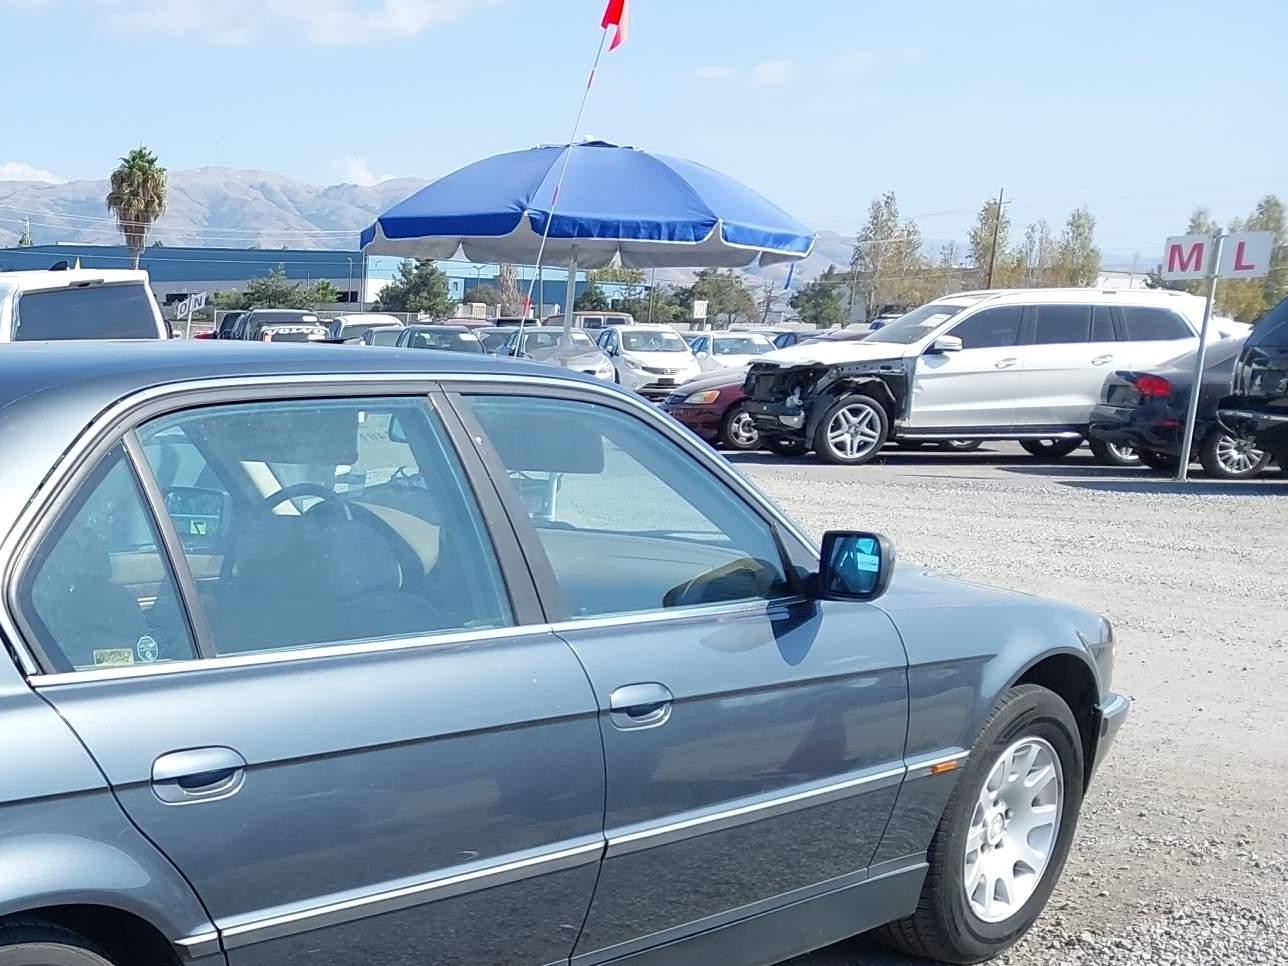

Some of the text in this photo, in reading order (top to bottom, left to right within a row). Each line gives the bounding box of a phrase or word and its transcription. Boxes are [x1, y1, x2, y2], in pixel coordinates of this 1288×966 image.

[1167, 242, 1205, 273] M
[1233, 241, 1256, 271] L
[194, 295, 203, 308] N
[263, 327, 326, 336] VOLVO
